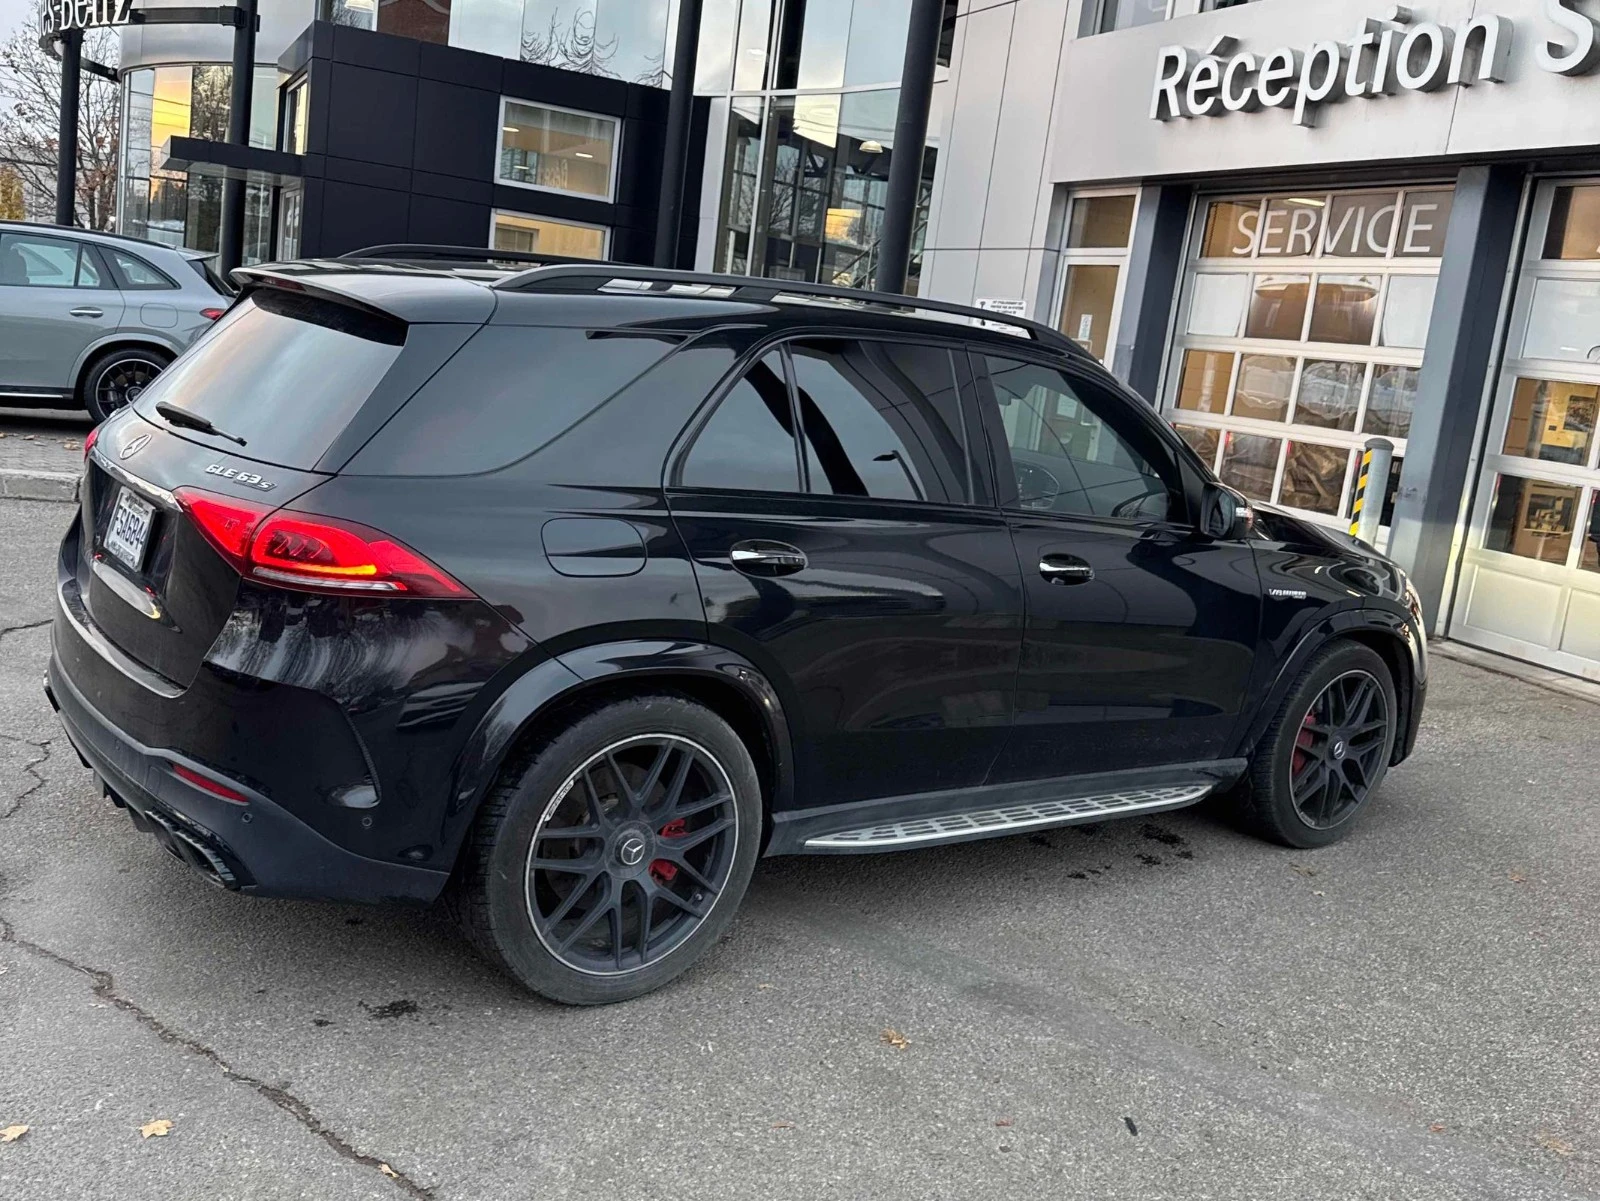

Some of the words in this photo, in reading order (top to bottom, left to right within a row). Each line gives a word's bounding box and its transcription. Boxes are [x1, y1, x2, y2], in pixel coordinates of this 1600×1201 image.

[1149, 4, 1507, 127] Réception
[1232, 203, 1439, 255] SERVICE
[205, 464, 238, 479] GLE
[237, 471, 262, 484] 63
